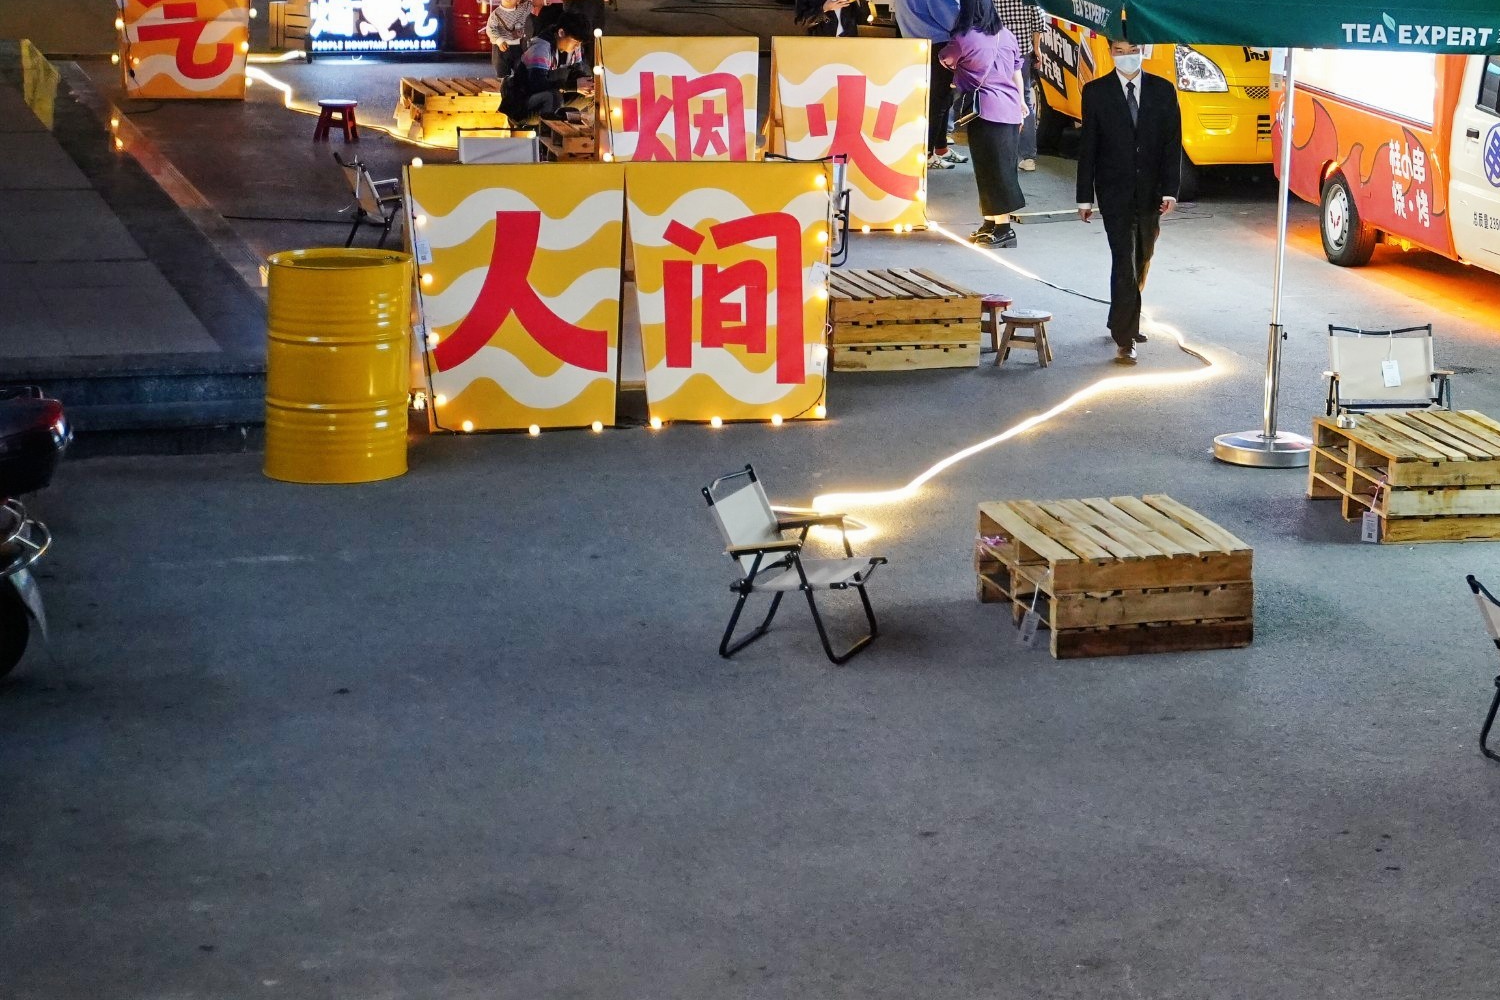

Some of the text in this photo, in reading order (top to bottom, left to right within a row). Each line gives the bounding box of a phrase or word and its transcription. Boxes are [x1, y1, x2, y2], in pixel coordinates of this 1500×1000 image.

[1084, 0, 1106, 25] EXPERT
[1341, 23, 1388, 43] TEA
[1398, 25, 1493, 46] EXPERT
[623, 72, 747, 161] 烟
[807, 75, 919, 200] 火
[432, 210, 608, 374] 人
[662, 210, 806, 385] 间
